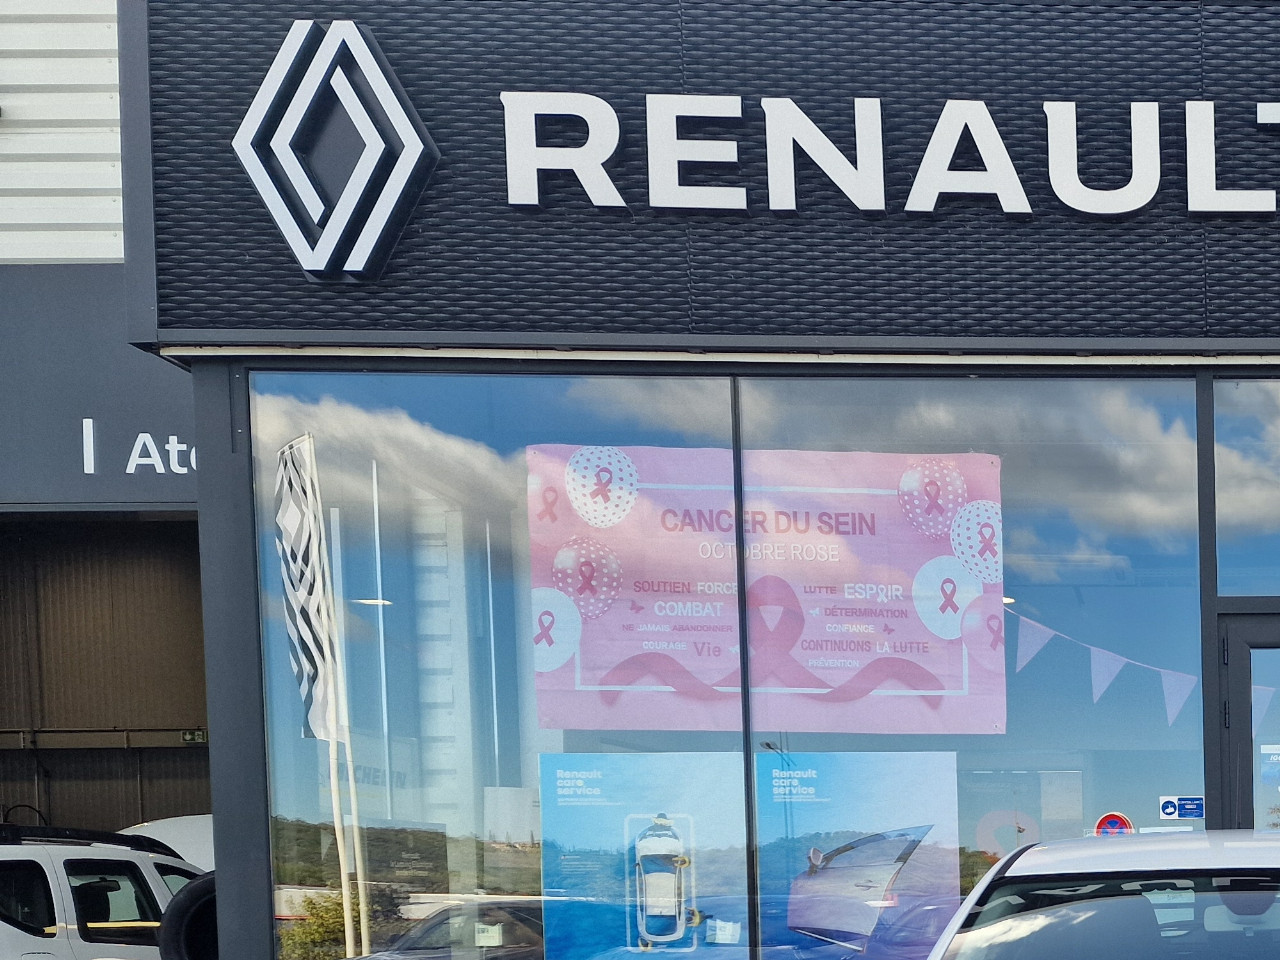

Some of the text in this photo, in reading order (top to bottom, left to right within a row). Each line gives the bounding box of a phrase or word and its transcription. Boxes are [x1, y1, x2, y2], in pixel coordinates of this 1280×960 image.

[660, 508, 876, 536] CANCER DU SEIN
[699, 541, 840, 562] OCTBRE ROSE
[634, 580, 690, 594] SOUTIEN
[803, 585, 837, 595] LUTTE
[654, 600, 724, 616] COMBAT
[824, 605, 908, 618] DÉTERMINATION
[622, 624, 733, 633] NE JAMAIS ABANDONNER
[825, 623, 875, 633] CONFIANCE
[642, 640, 722, 657] COURAGE Vie
[801, 639, 929, 653] CONTINUONS LA LUTTE
[808, 656, 860, 668] PRÉVENTION
[556, 769, 602, 779] Renault
[772, 769, 817, 778] Renault
[556, 779, 584, 787] care
[556, 786, 601, 795] service
[772, 785, 815, 794] service
